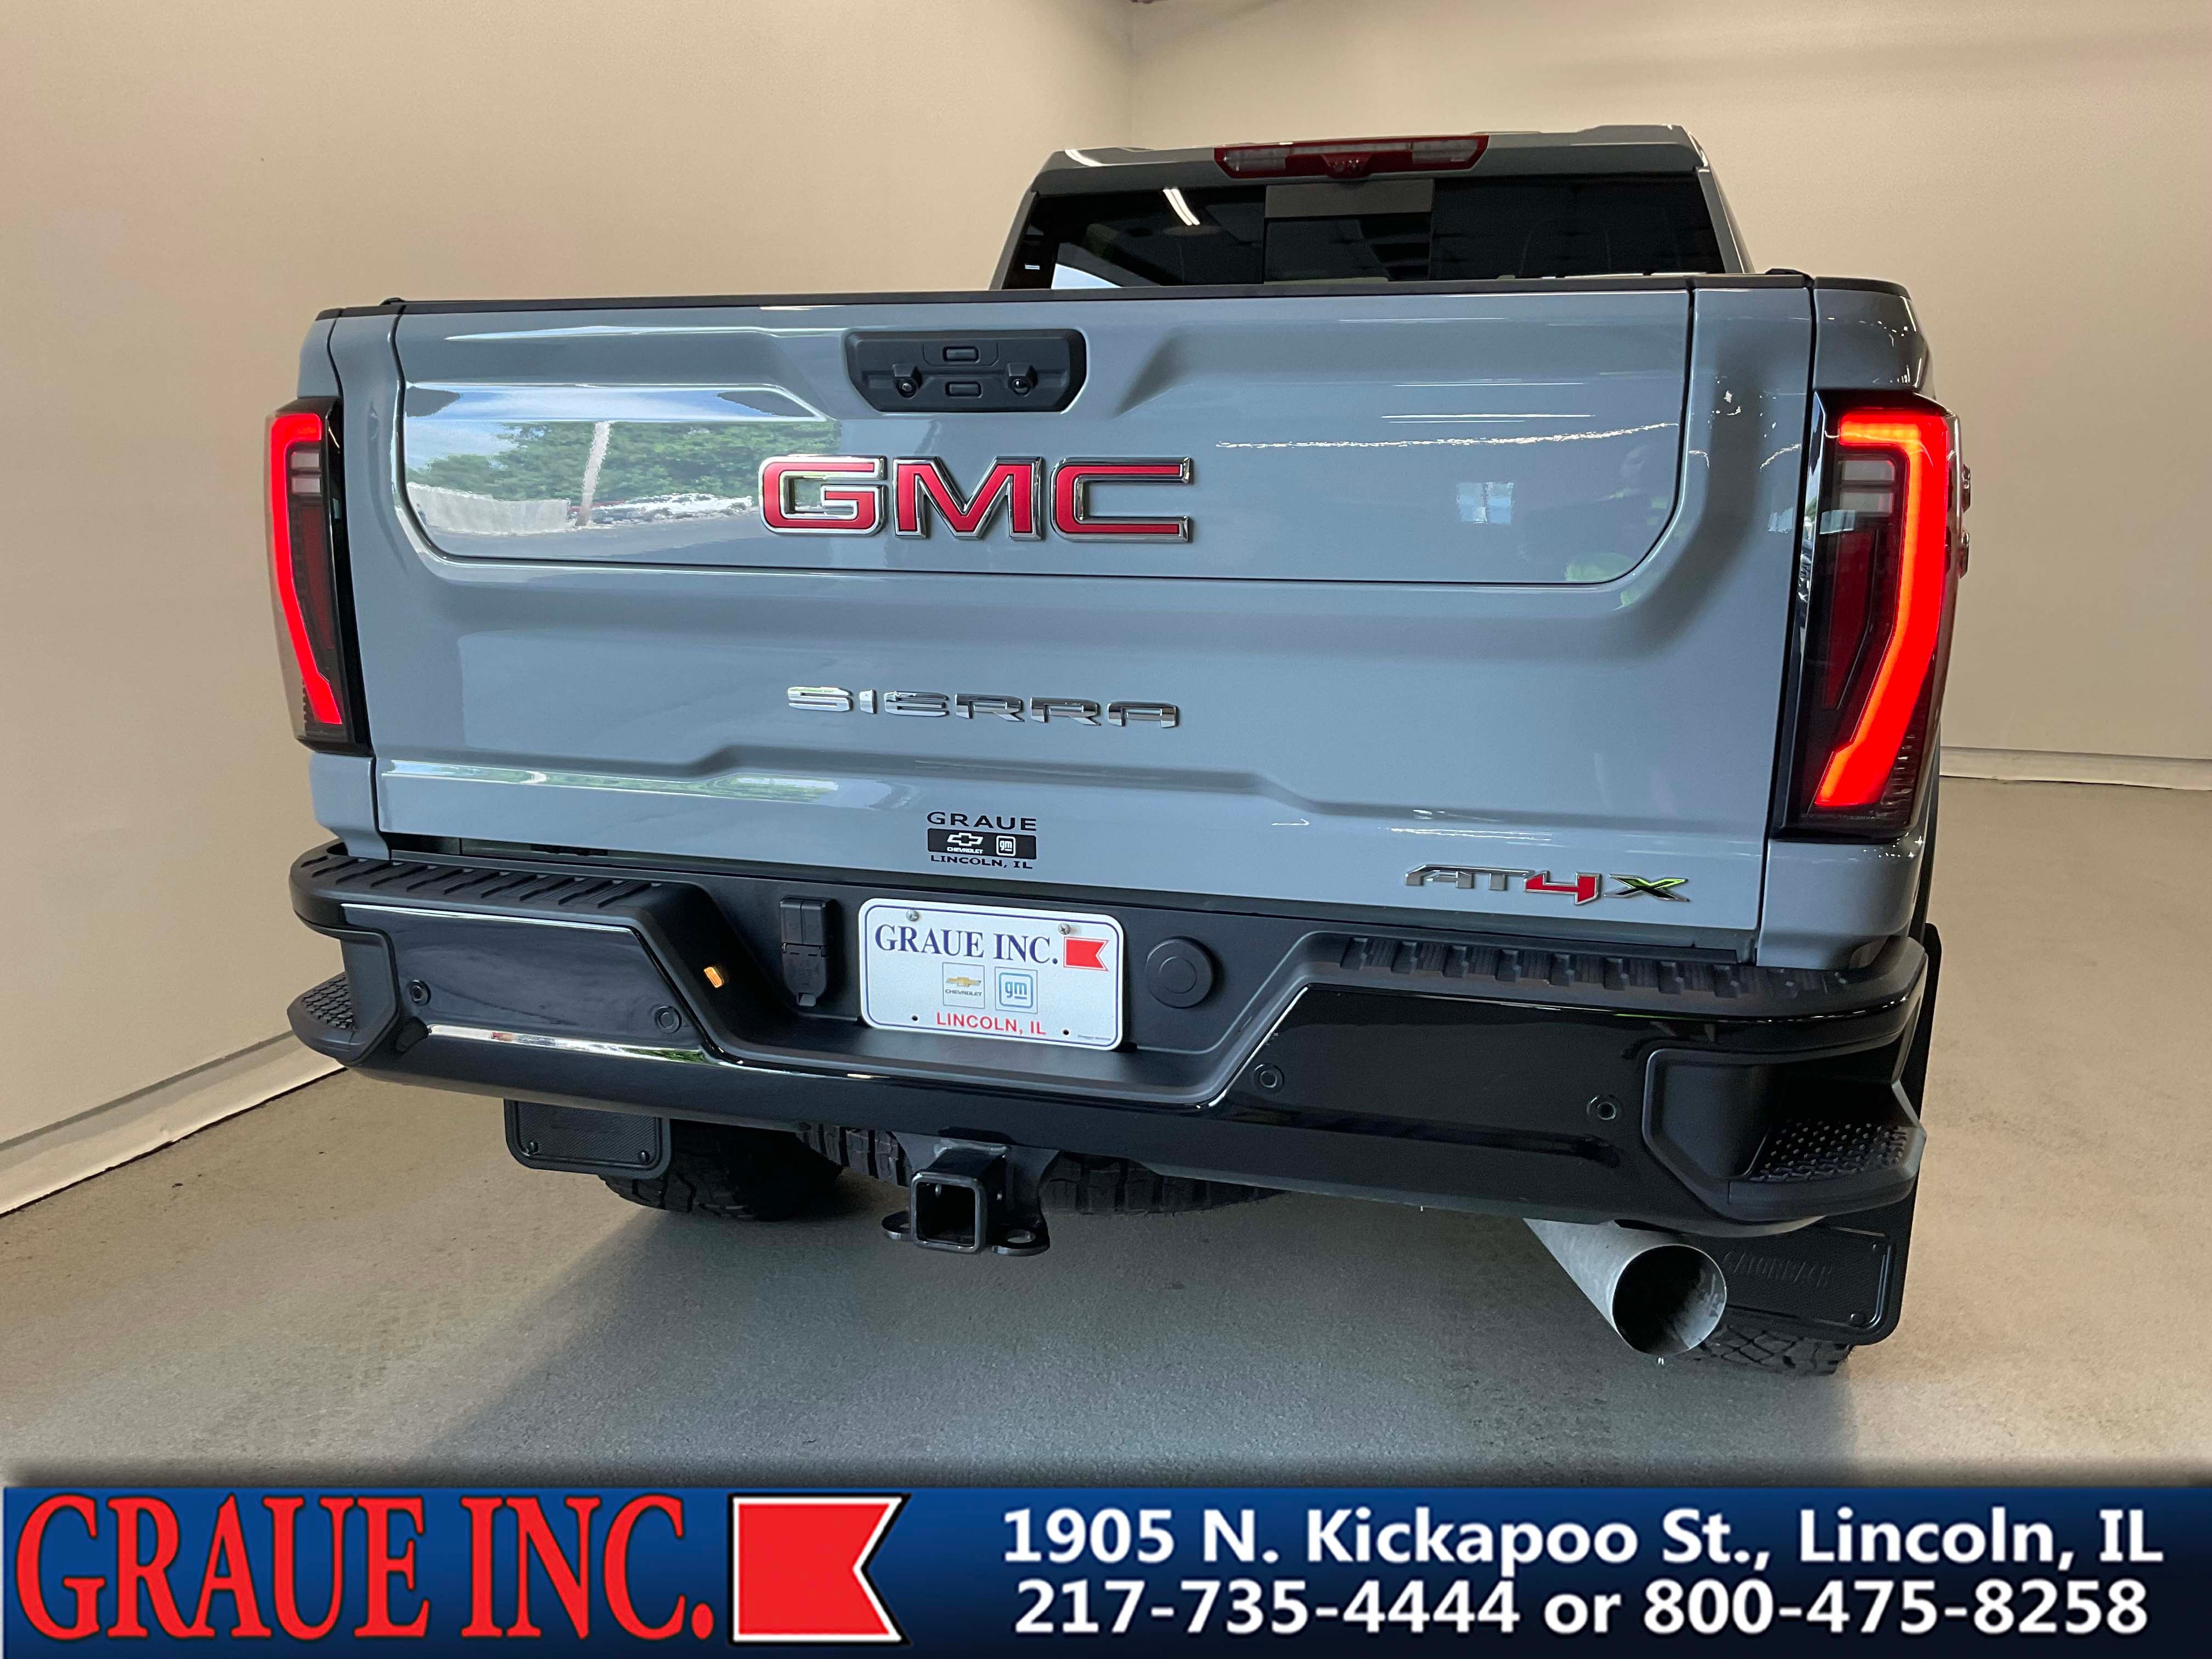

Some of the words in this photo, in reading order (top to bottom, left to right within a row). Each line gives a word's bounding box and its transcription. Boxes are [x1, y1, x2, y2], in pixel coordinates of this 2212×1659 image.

[759, 455, 1191, 543] GMC
[787, 686, 1180, 729] SIERRA
[927, 811, 1036, 831] GRAUE
[1000, 840, 1013, 851] gm
[931, 855, 1007, 868] LINCOLN,
[1014, 861, 1032, 869] IL
[1405, 864, 1690, 905] AT4X
[874, 924, 984, 959] GRAUE
[992, 933, 1058, 965] INC.
[945, 989, 983, 997] CHEVROLET
[1005, 981, 1028, 998] gm
[936, 1012, 1023, 1035] LINCOLN,
[1030, 1020, 1046, 1035] IL
